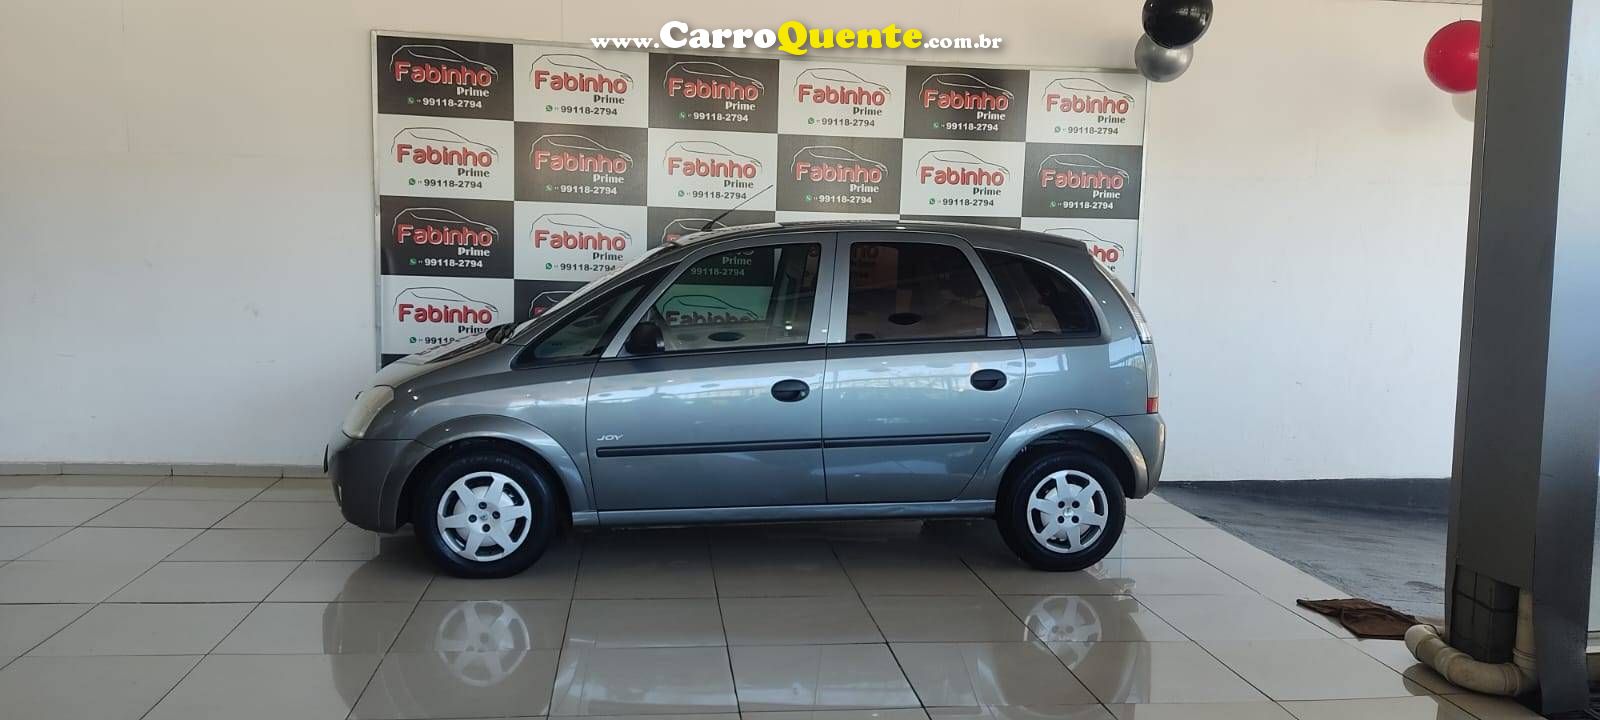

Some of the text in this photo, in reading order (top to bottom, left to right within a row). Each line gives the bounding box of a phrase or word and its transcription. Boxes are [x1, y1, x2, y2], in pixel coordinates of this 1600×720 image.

[394, 61, 491, 86] Fabinho
[535, 70, 627, 94] Fabinho
[457, 86, 489, 97] Prime
[668, 78, 758, 100] Fabinho
[593, 94, 625, 104] Prime
[799, 85, 885, 105] Fabinho
[924, 89, 1008, 111] Fabinho
[423, 98, 482, 109] 99118-2794
[726, 101, 756, 111] Prime
[1046, 94, 1129, 114] Fabinho
[561, 105, 617, 116] 99118-2794
[853, 106, 883, 116] Prime
[694, 112, 749, 122] 99118-2794
[977, 111, 1006, 121] Prime
[1098, 115, 1126, 124] Prime
[822, 117, 875, 127] 99118-2794
[946, 122, 999, 132] 99118-2794
[1068, 126, 1118, 135] 99118-2794
[397, 144, 492, 167] Fabinho
[535, 151, 627, 174] Fabinho
[668, 157, 756, 178] Fabinho
[458, 168, 490, 178] Prime
[795, 162, 882, 183] Fabinho
[920, 166, 1004, 186] Fabinho
[424, 179, 482, 189] 99118-2794
[593, 174, 624, 184] Prime
[724, 179, 754, 189] Prime
[1041, 169, 1123, 189] Fabinho
[561, 185, 617, 195] 99118-2794
[850, 184, 879, 193] Prime
[973, 187, 1001, 196] Prime
[692, 190, 747, 200] 99118-2794
[1093, 189, 1121, 199] Prime
[819, 195, 872, 204] 99118-2794
[943, 198, 994, 207] 99118-2794
[1064, 201, 1113, 210] 99118-2794
[397, 224, 492, 246] Fabinho
[535, 230, 625, 250] Fabinho
[458, 247, 490, 257] Prime
[592, 252, 624, 261] Prime
[424, 258, 483, 268] 99118-2794
[398, 304, 492, 324] Fabinho
